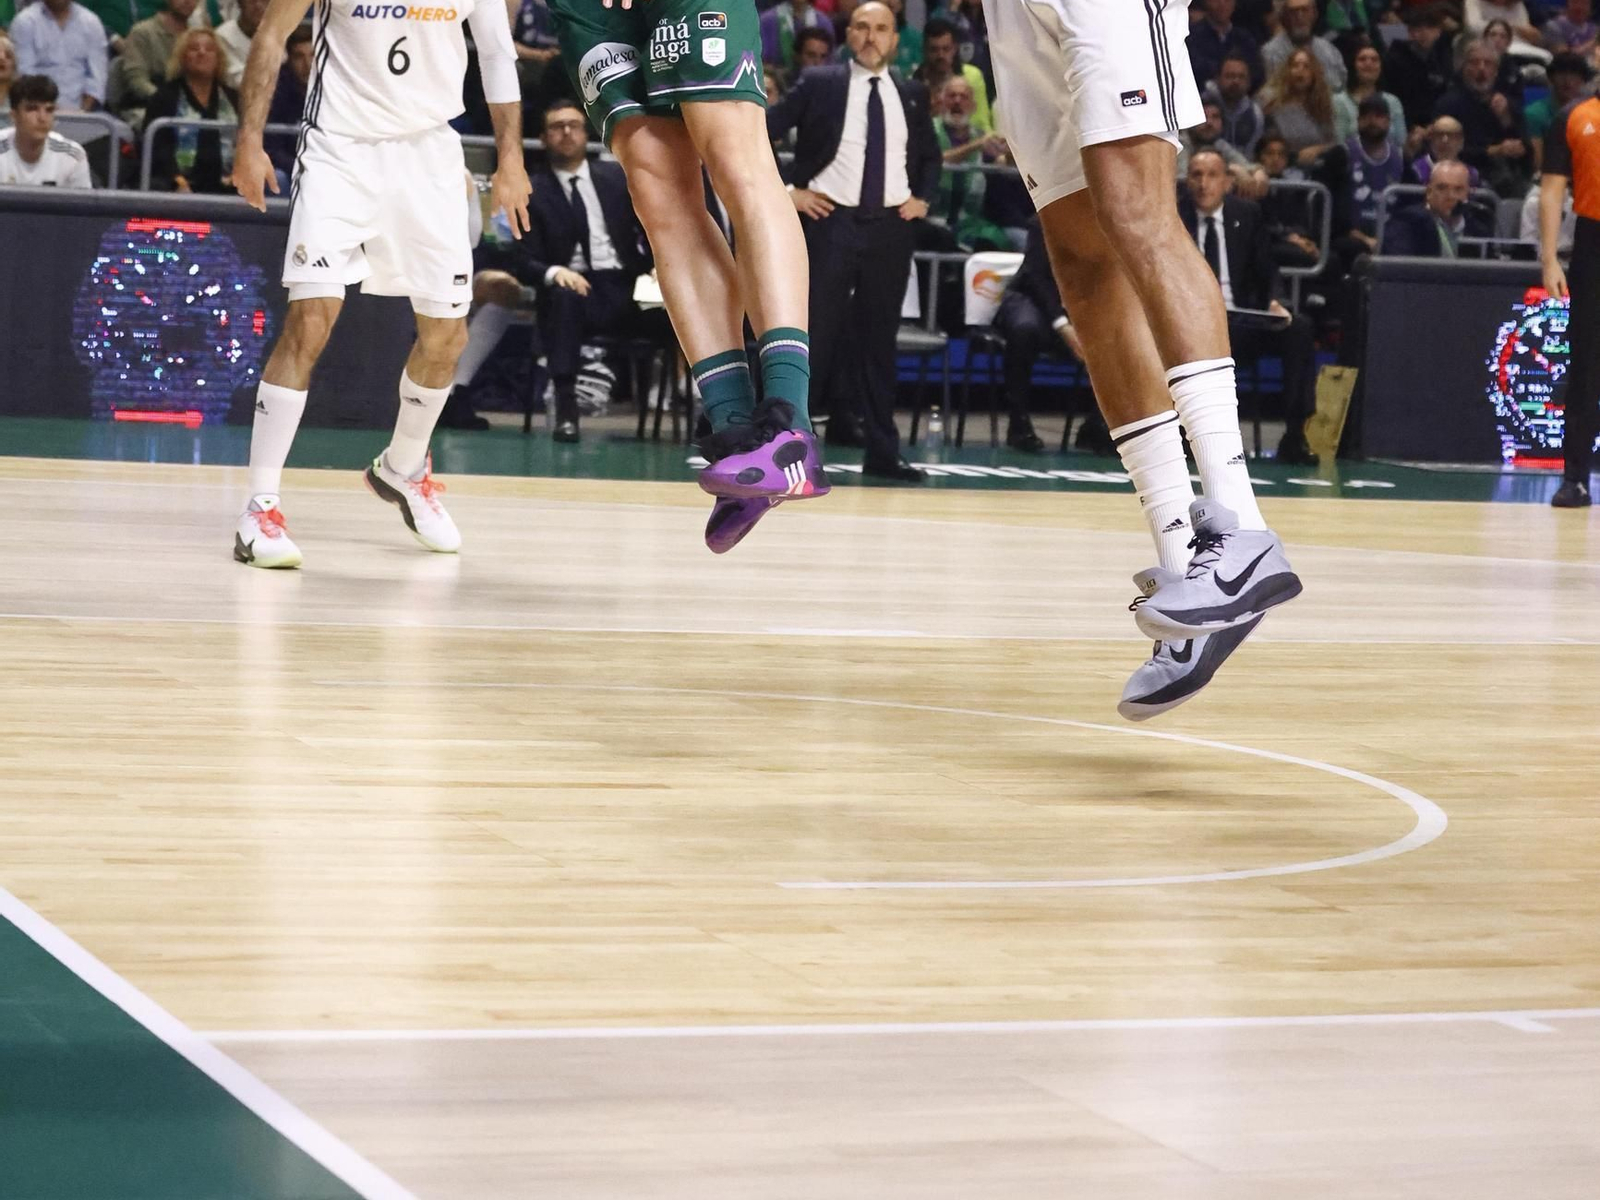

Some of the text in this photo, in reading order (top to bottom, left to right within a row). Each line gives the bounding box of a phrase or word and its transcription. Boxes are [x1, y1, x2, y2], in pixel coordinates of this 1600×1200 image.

[352, 4, 458, 22] AUTOHERO
[702, 19, 720, 27] acb
[388, 36, 411, 76] 6
[650, 39, 691, 63] laga
[1123, 96, 1142, 105] acb
